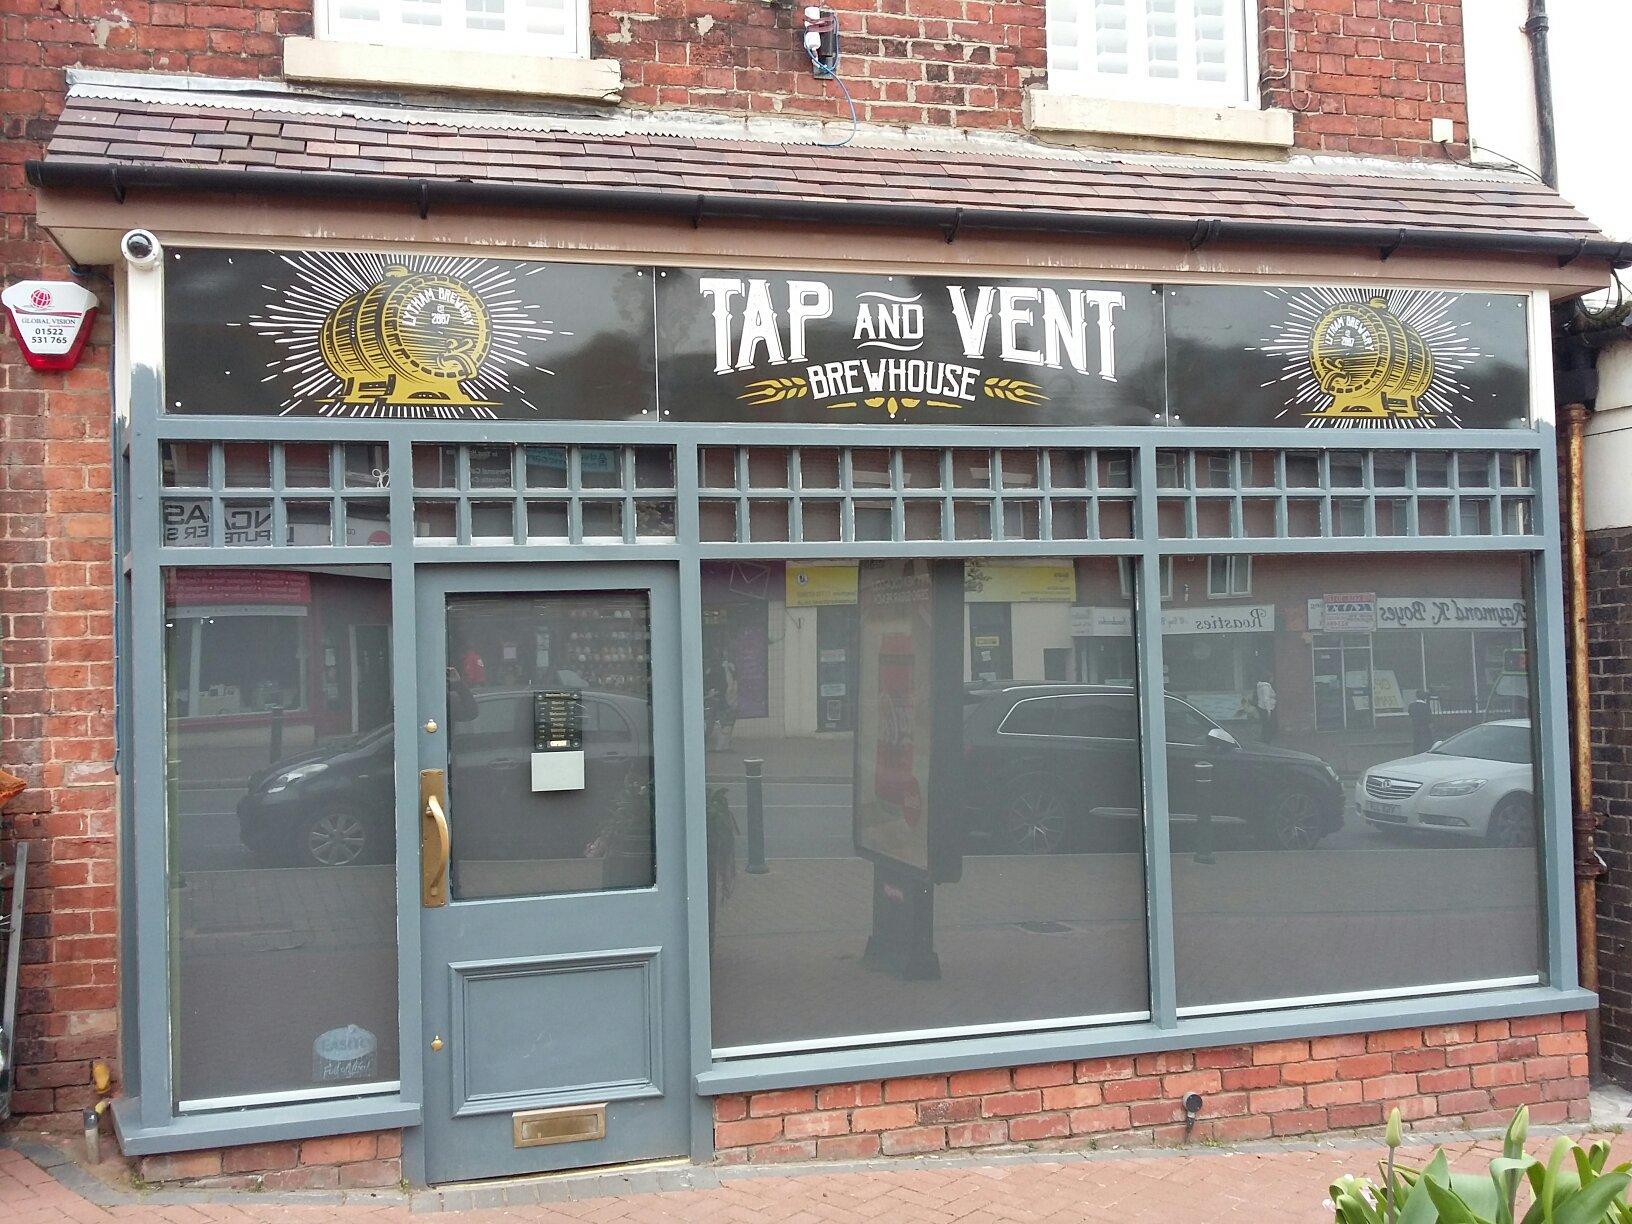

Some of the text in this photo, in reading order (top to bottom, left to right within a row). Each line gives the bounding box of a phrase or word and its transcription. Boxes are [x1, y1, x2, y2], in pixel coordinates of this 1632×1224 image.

[402, 287, 474, 326] LYTHAM BREWERY
[700, 278, 1125, 382] TAP AND VENT
[806, 359, 980, 400] BREWHOUSE
